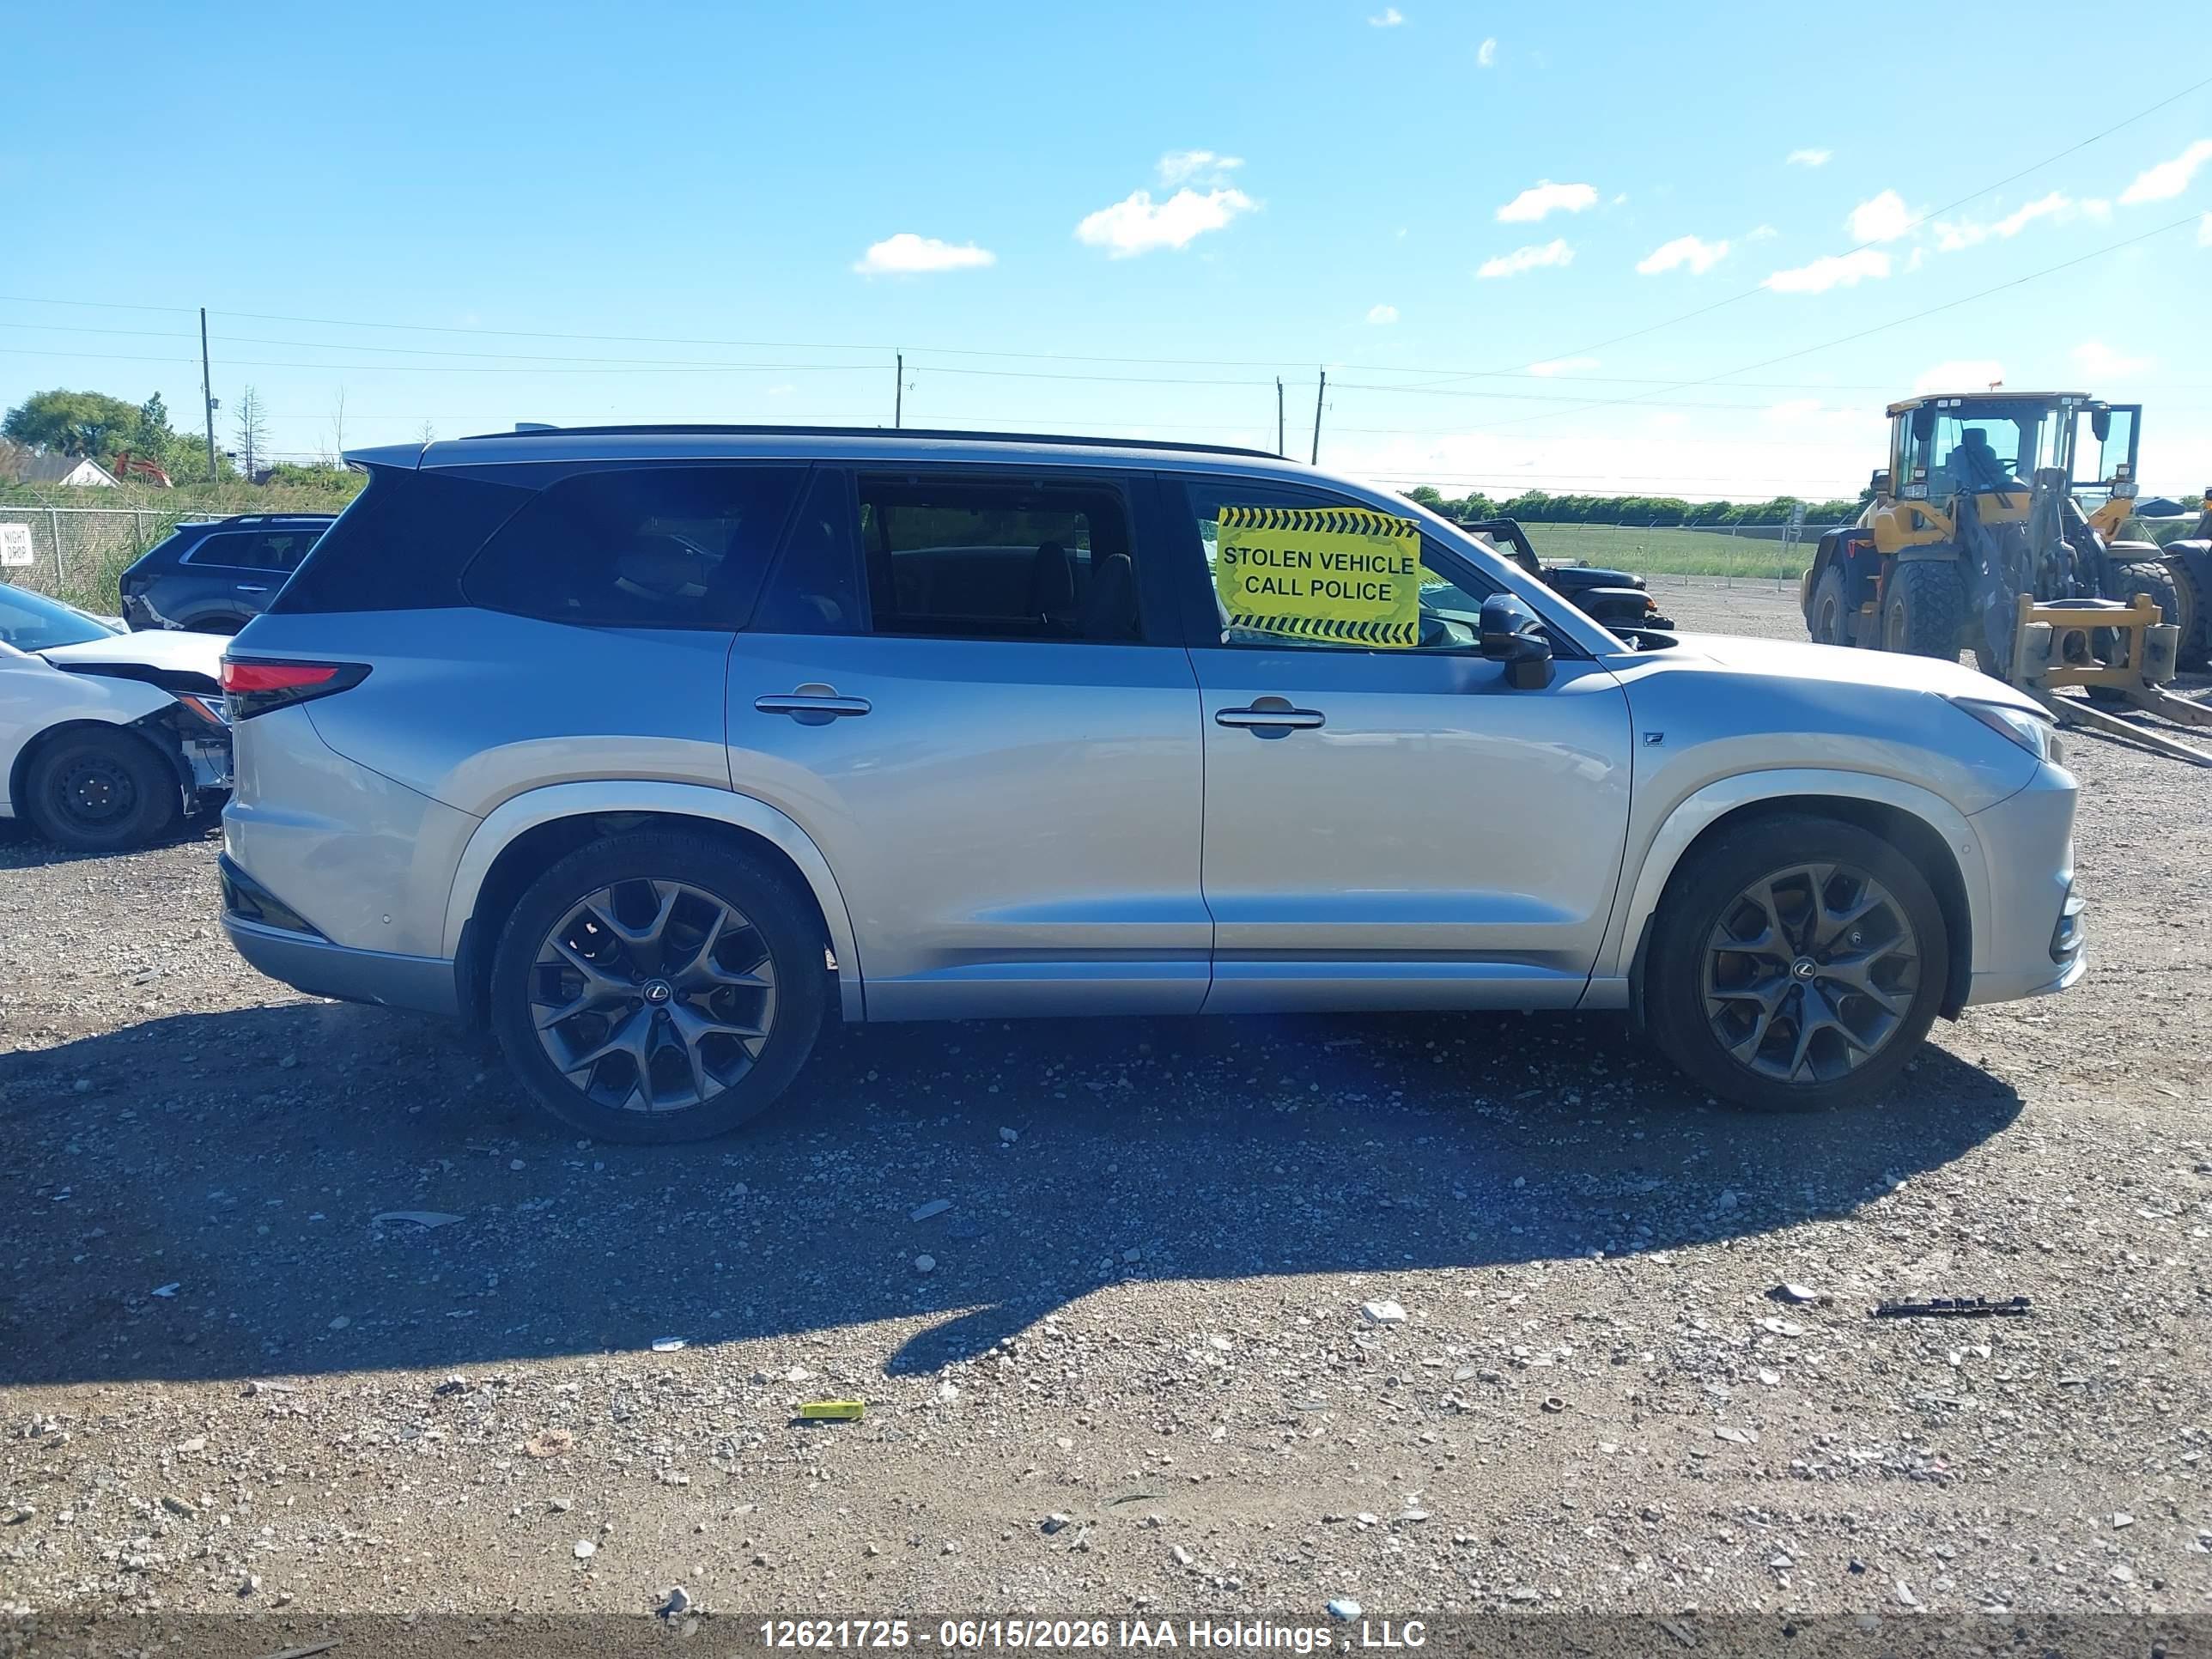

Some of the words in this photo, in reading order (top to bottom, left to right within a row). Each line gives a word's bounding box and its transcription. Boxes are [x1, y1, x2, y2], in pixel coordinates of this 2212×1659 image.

[4, 530, 26, 544] NIGHT
[8, 545, 27, 559] DROP
[1224, 546, 1312, 568] STOLEN
[1320, 552, 1415, 575] VEHICLE
[1245, 575, 1304, 597] CALL
[1310, 580, 1392, 601] POLICE
